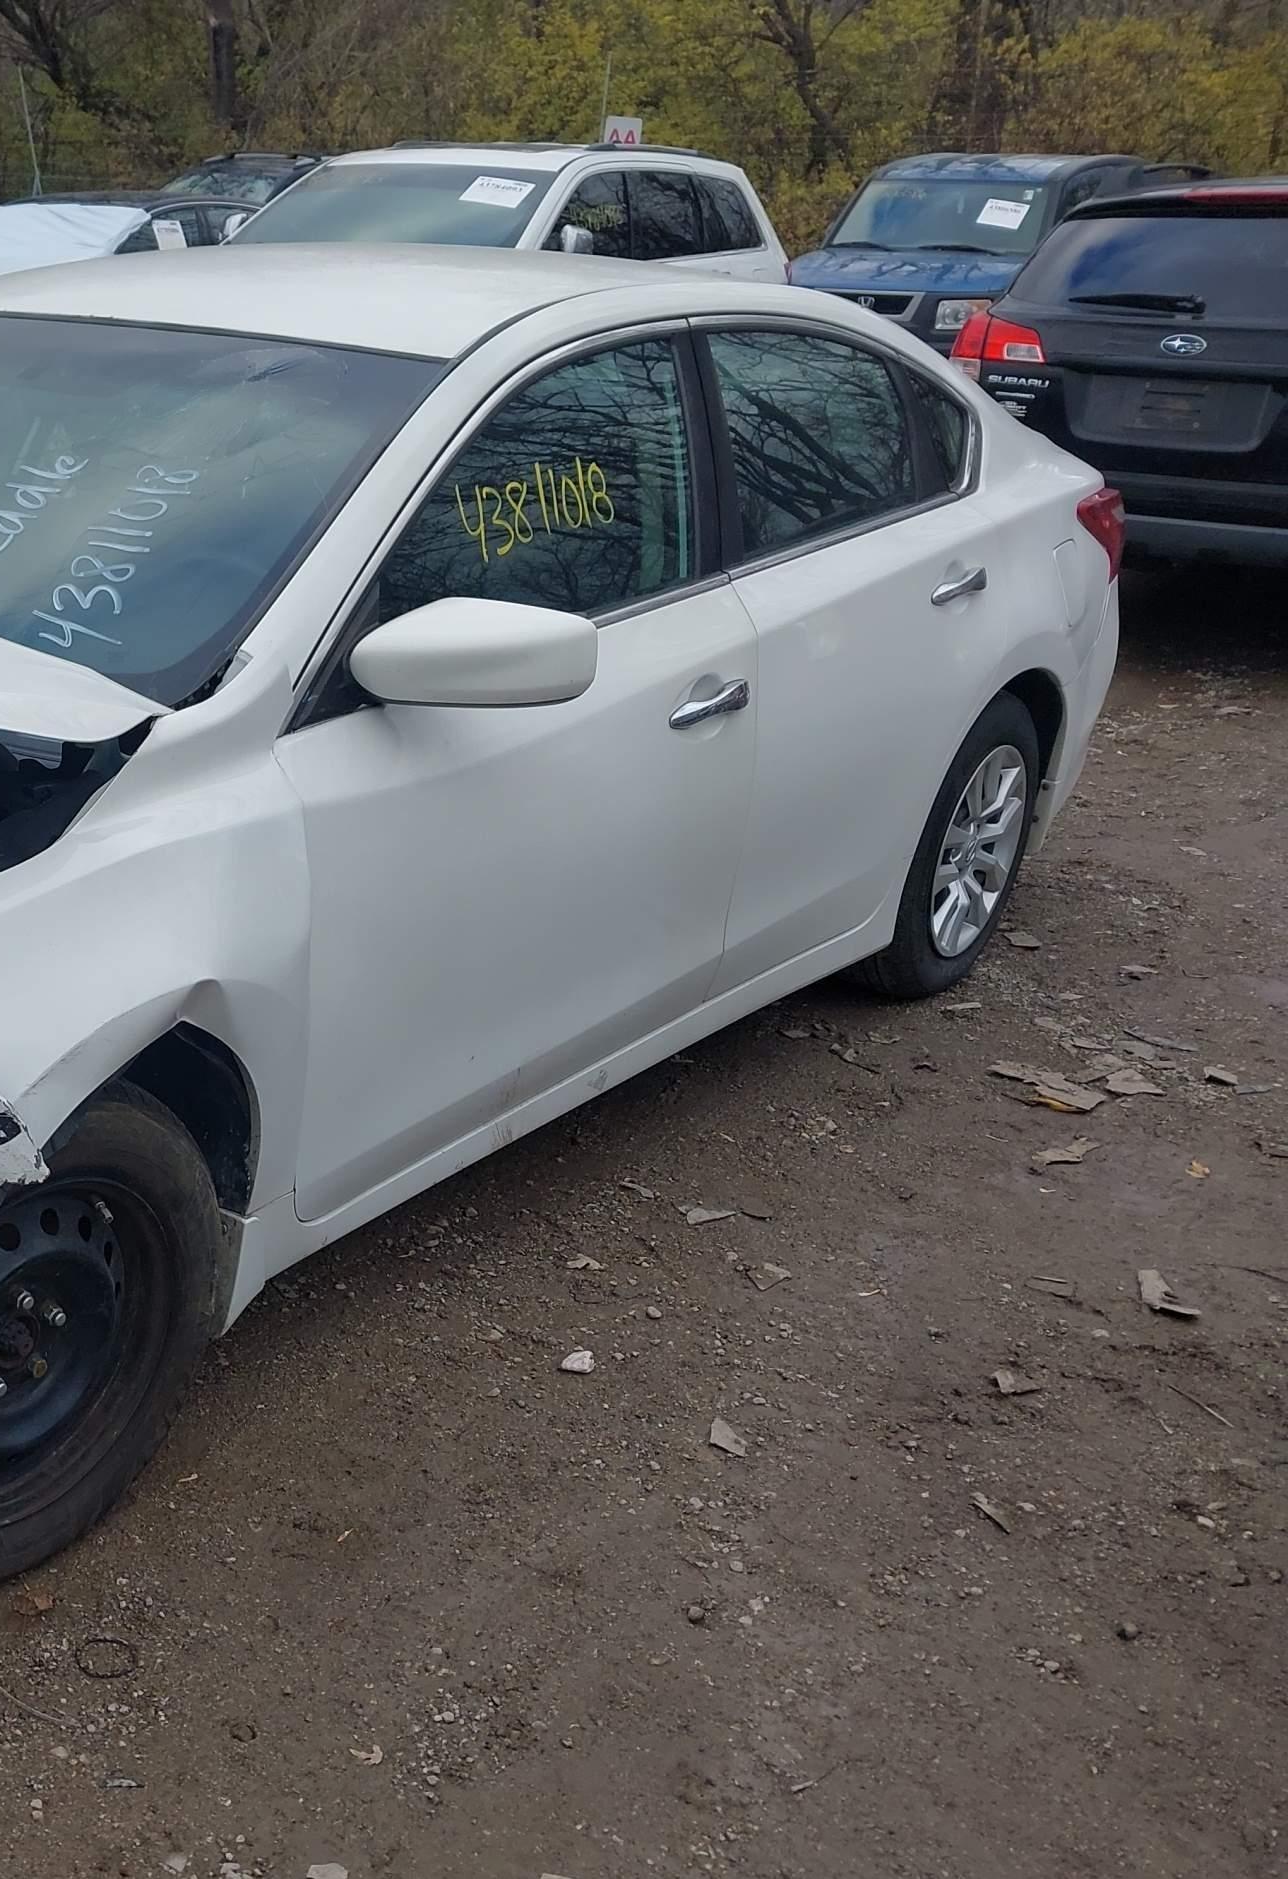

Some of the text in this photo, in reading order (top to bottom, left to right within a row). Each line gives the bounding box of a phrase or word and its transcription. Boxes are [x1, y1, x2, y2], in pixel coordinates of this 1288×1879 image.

[988, 374, 1050, 388] SUBARU
[32, 464, 200, 648] 43811018
[455, 456, 615, 563] 43811018
